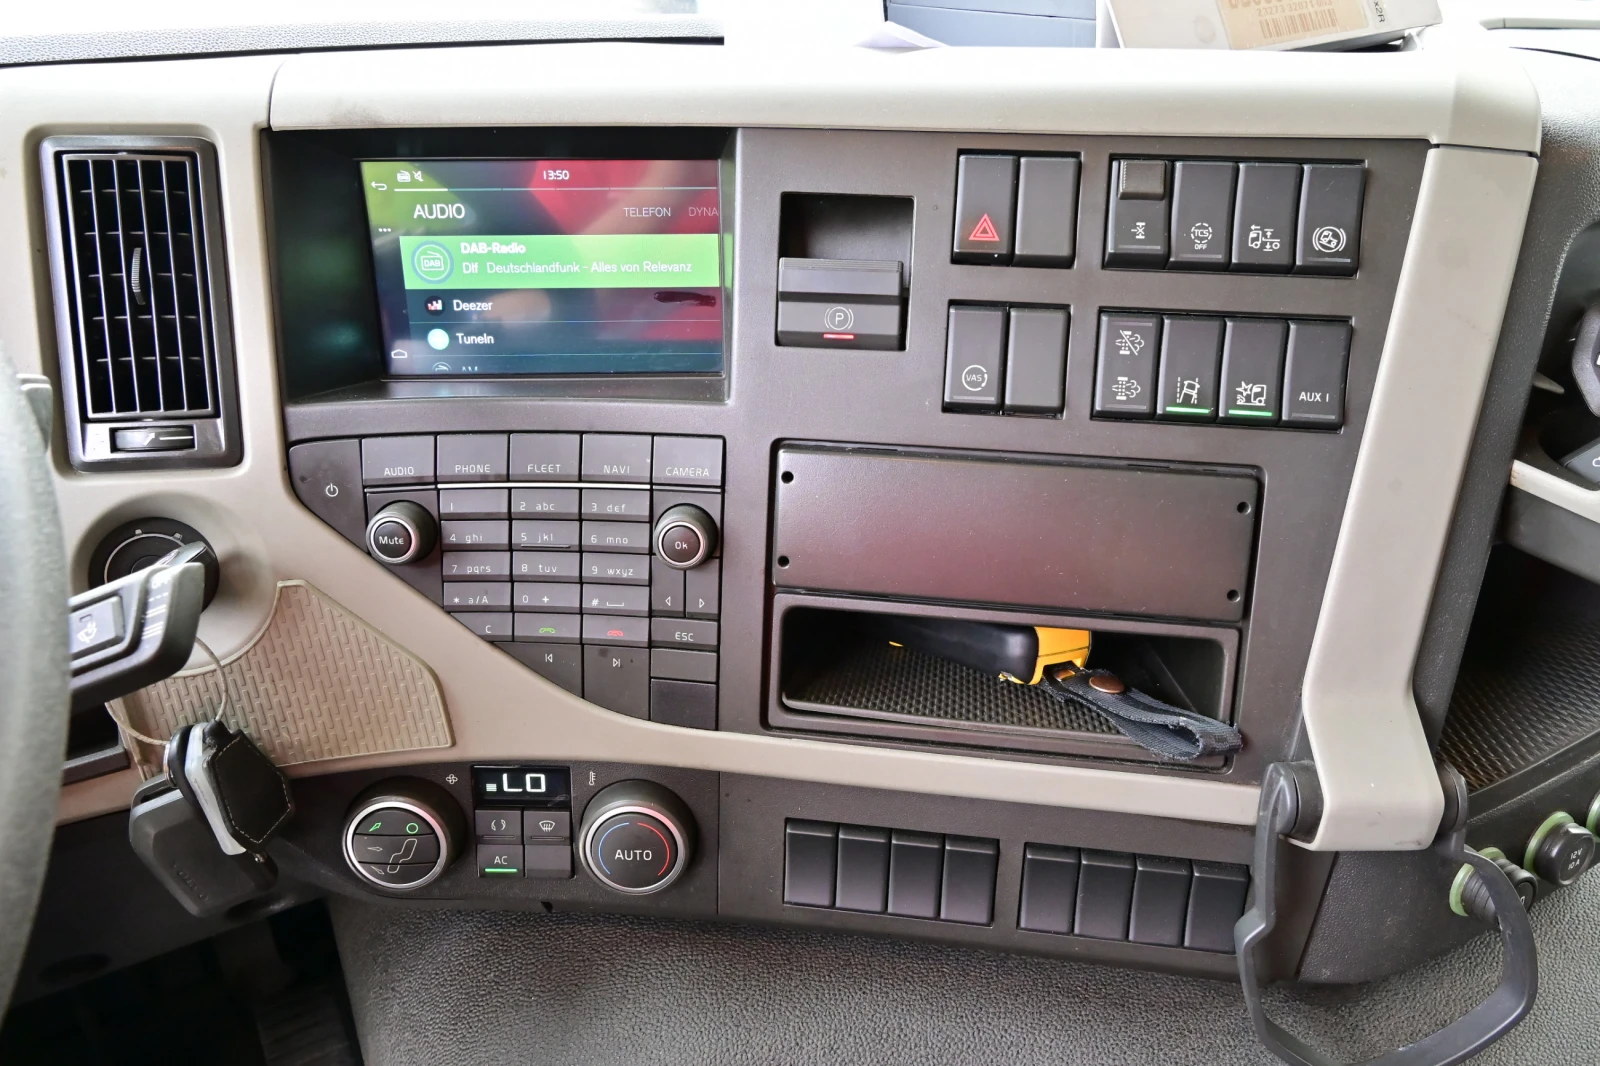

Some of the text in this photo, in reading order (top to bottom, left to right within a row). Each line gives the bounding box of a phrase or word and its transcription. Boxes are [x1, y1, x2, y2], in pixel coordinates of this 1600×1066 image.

[543, 169, 570, 181] 13:50
[413, 203, 466, 219] AUDIO
[623, 207, 672, 218] TELEFON
[688, 206, 719, 217] DYNA
[1194, 229, 1209, 237] TCS
[460, 242, 527, 254] DAB-Radio
[423, 259, 442, 267] DAB
[486, 261, 581, 274] Deutschlandfunk
[590, 261, 618, 273] Alles
[620, 263, 640, 273] von
[643, 260, 693, 272] Relevanz
[453, 299, 494, 311] Deezer
[455, 332, 495, 345] TuneIn
[966, 374, 982, 382] VAS
[1299, 391, 1322, 403] AUX
[383, 466, 415, 476] AUDIO
[454, 463, 491, 474] PHONE
[527, 463, 561, 473] FLEET
[603, 464, 630, 474] NAVI
[664, 467, 710, 478] CAMERA
[519, 501, 556, 512] 2 abc
[591, 503, 626, 513] 3 def
[378, 534, 406, 546] Mute
[449, 533, 484, 545] 4 ghi
[520, 532, 555, 545] 5 jkl
[590, 535, 629, 545] 6 mno
[674, 540, 689, 551] Ok
[451, 564, 492, 575] 7 pqrs
[521, 563, 558, 573] 8 tuv
[591, 565, 634, 577] 9 wxyz
[468, 595, 490, 605] a/A
[591, 598, 600, 608] #
[485, 624, 492, 635] C
[674, 630, 694, 642] ESC
[493, 855, 508, 865] AC
[614, 848, 653, 862] AUTO
